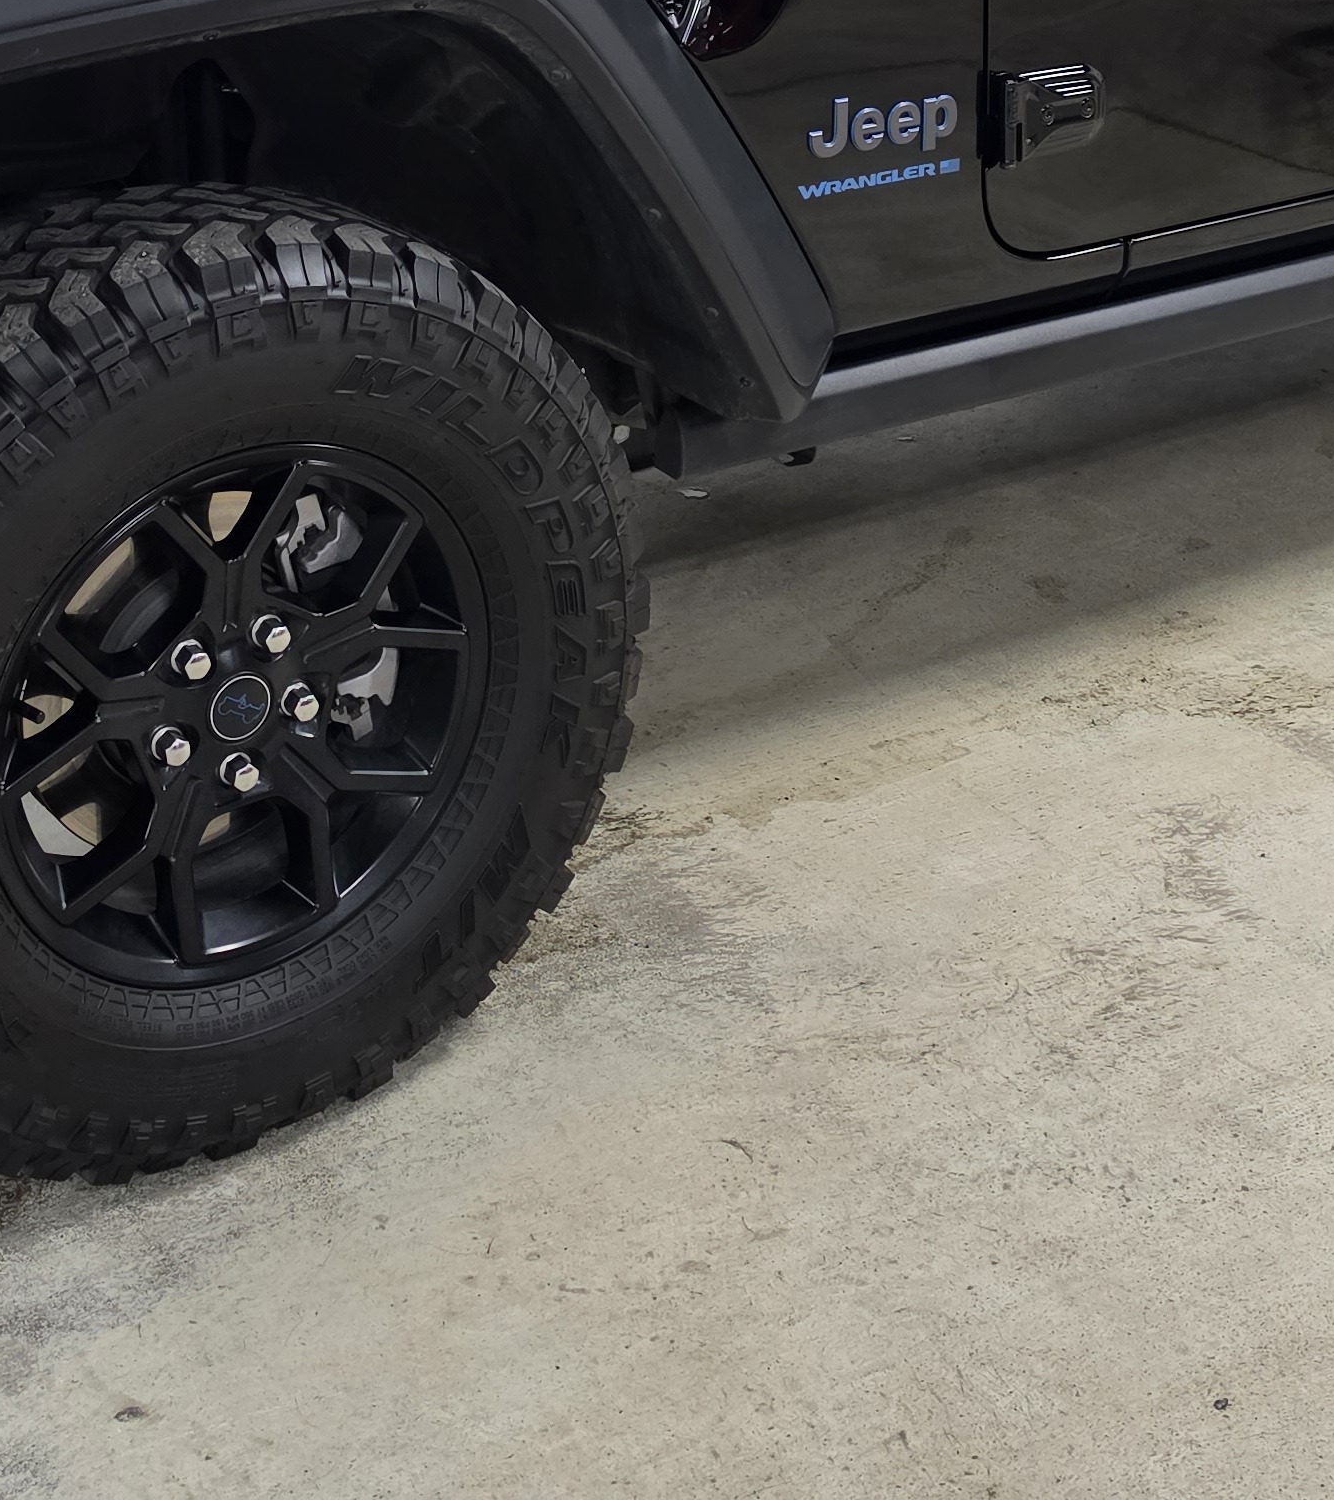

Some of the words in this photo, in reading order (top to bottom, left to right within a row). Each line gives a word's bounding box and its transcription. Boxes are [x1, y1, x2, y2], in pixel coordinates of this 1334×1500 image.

[807, 94, 958, 159] Jeep
[797, 162, 936, 200] WRANGLER
[331, 354, 588, 768] WILDPEAK
